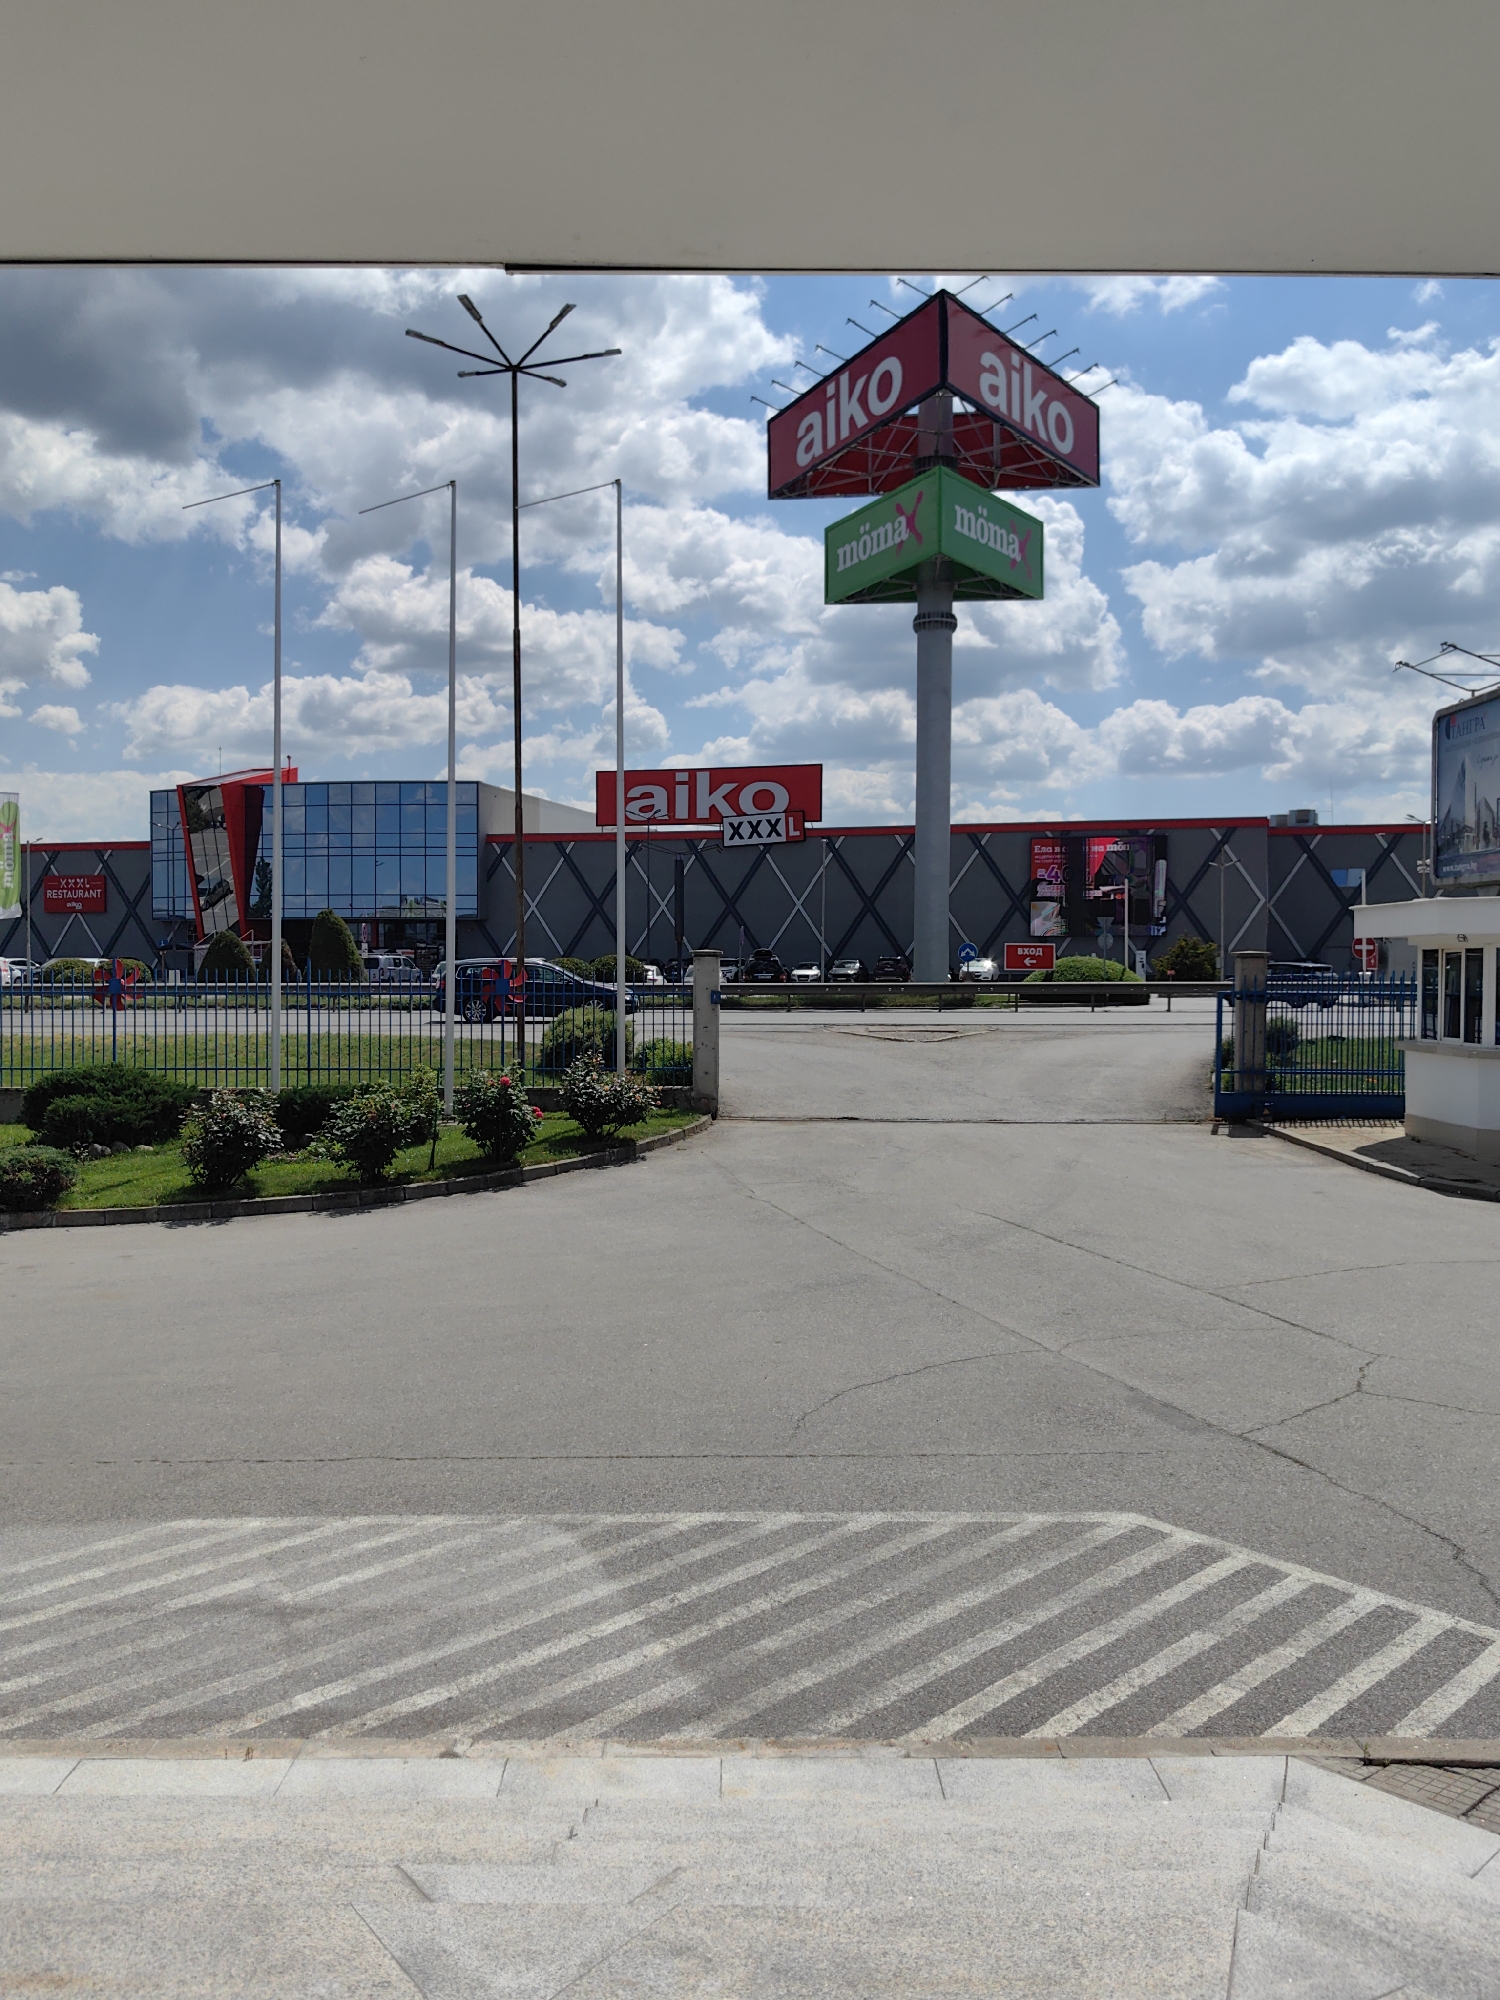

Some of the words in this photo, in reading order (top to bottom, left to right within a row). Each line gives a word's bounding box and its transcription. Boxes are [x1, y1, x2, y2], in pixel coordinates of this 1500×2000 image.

[796, 356, 903, 467] aiko
[979, 352, 1074, 455] aiko
[1450, 716, 1486, 740] ТАНГРА
[625, 771, 790, 821] aiko
[1034, 845, 1053, 853] Ела
[60, 878, 90, 888] XXXL
[46, 889, 102, 899] RESTAURANT
[1017, 947, 1043, 957] ВХОД
